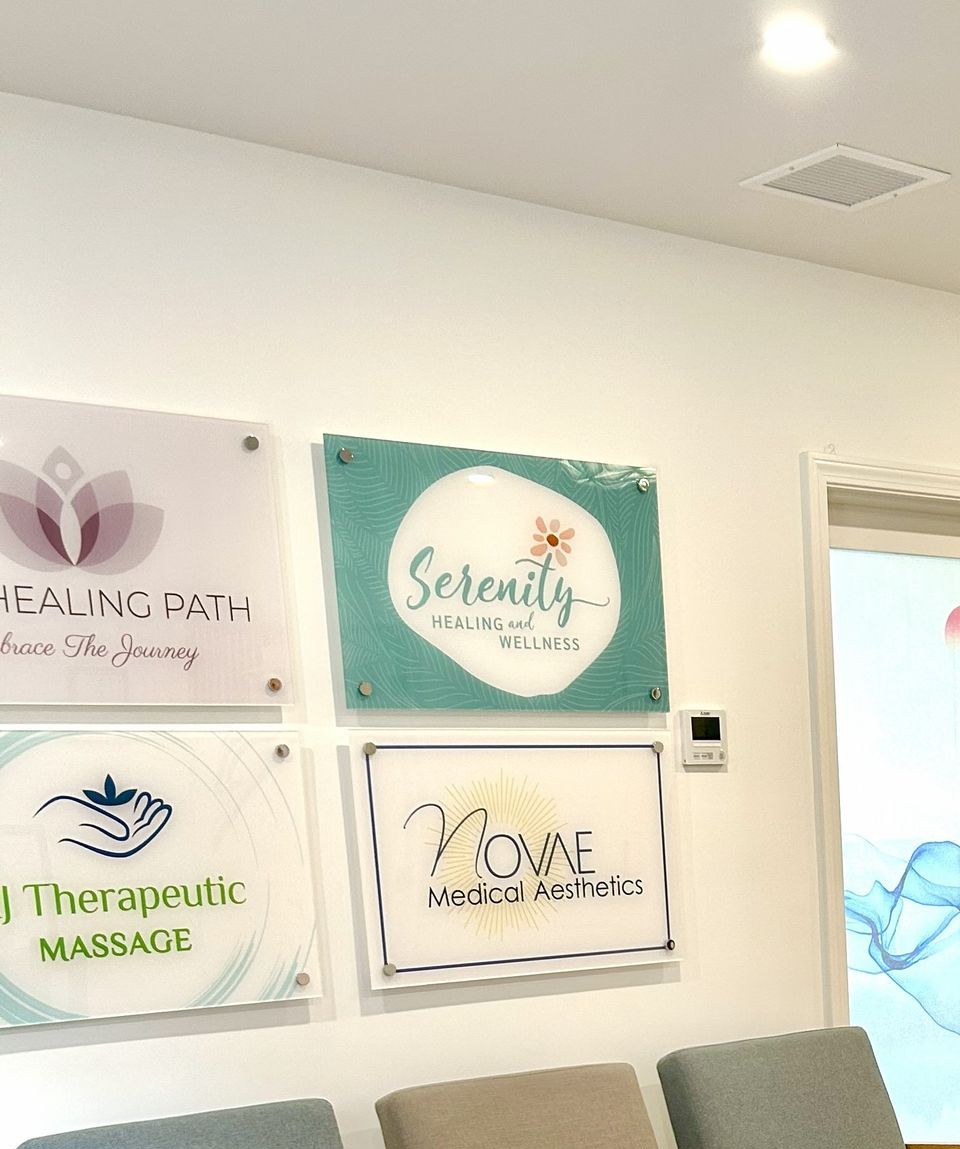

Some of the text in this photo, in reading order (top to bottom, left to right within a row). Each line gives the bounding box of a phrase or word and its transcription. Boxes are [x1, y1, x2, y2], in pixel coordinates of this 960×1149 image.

[406, 545, 611, 628] Serenity
[164, 592, 251, 622] PATH
[432, 611, 535, 631] HEALING and
[0, 631, 200, 672] brace The Journey
[499, 635, 580, 651] WELLNESS
[0, 875, 248, 926] J Therapeutic
[428, 874, 644, 908] Medical Aesthetics
[39, 928, 193, 962] MASSAGE
